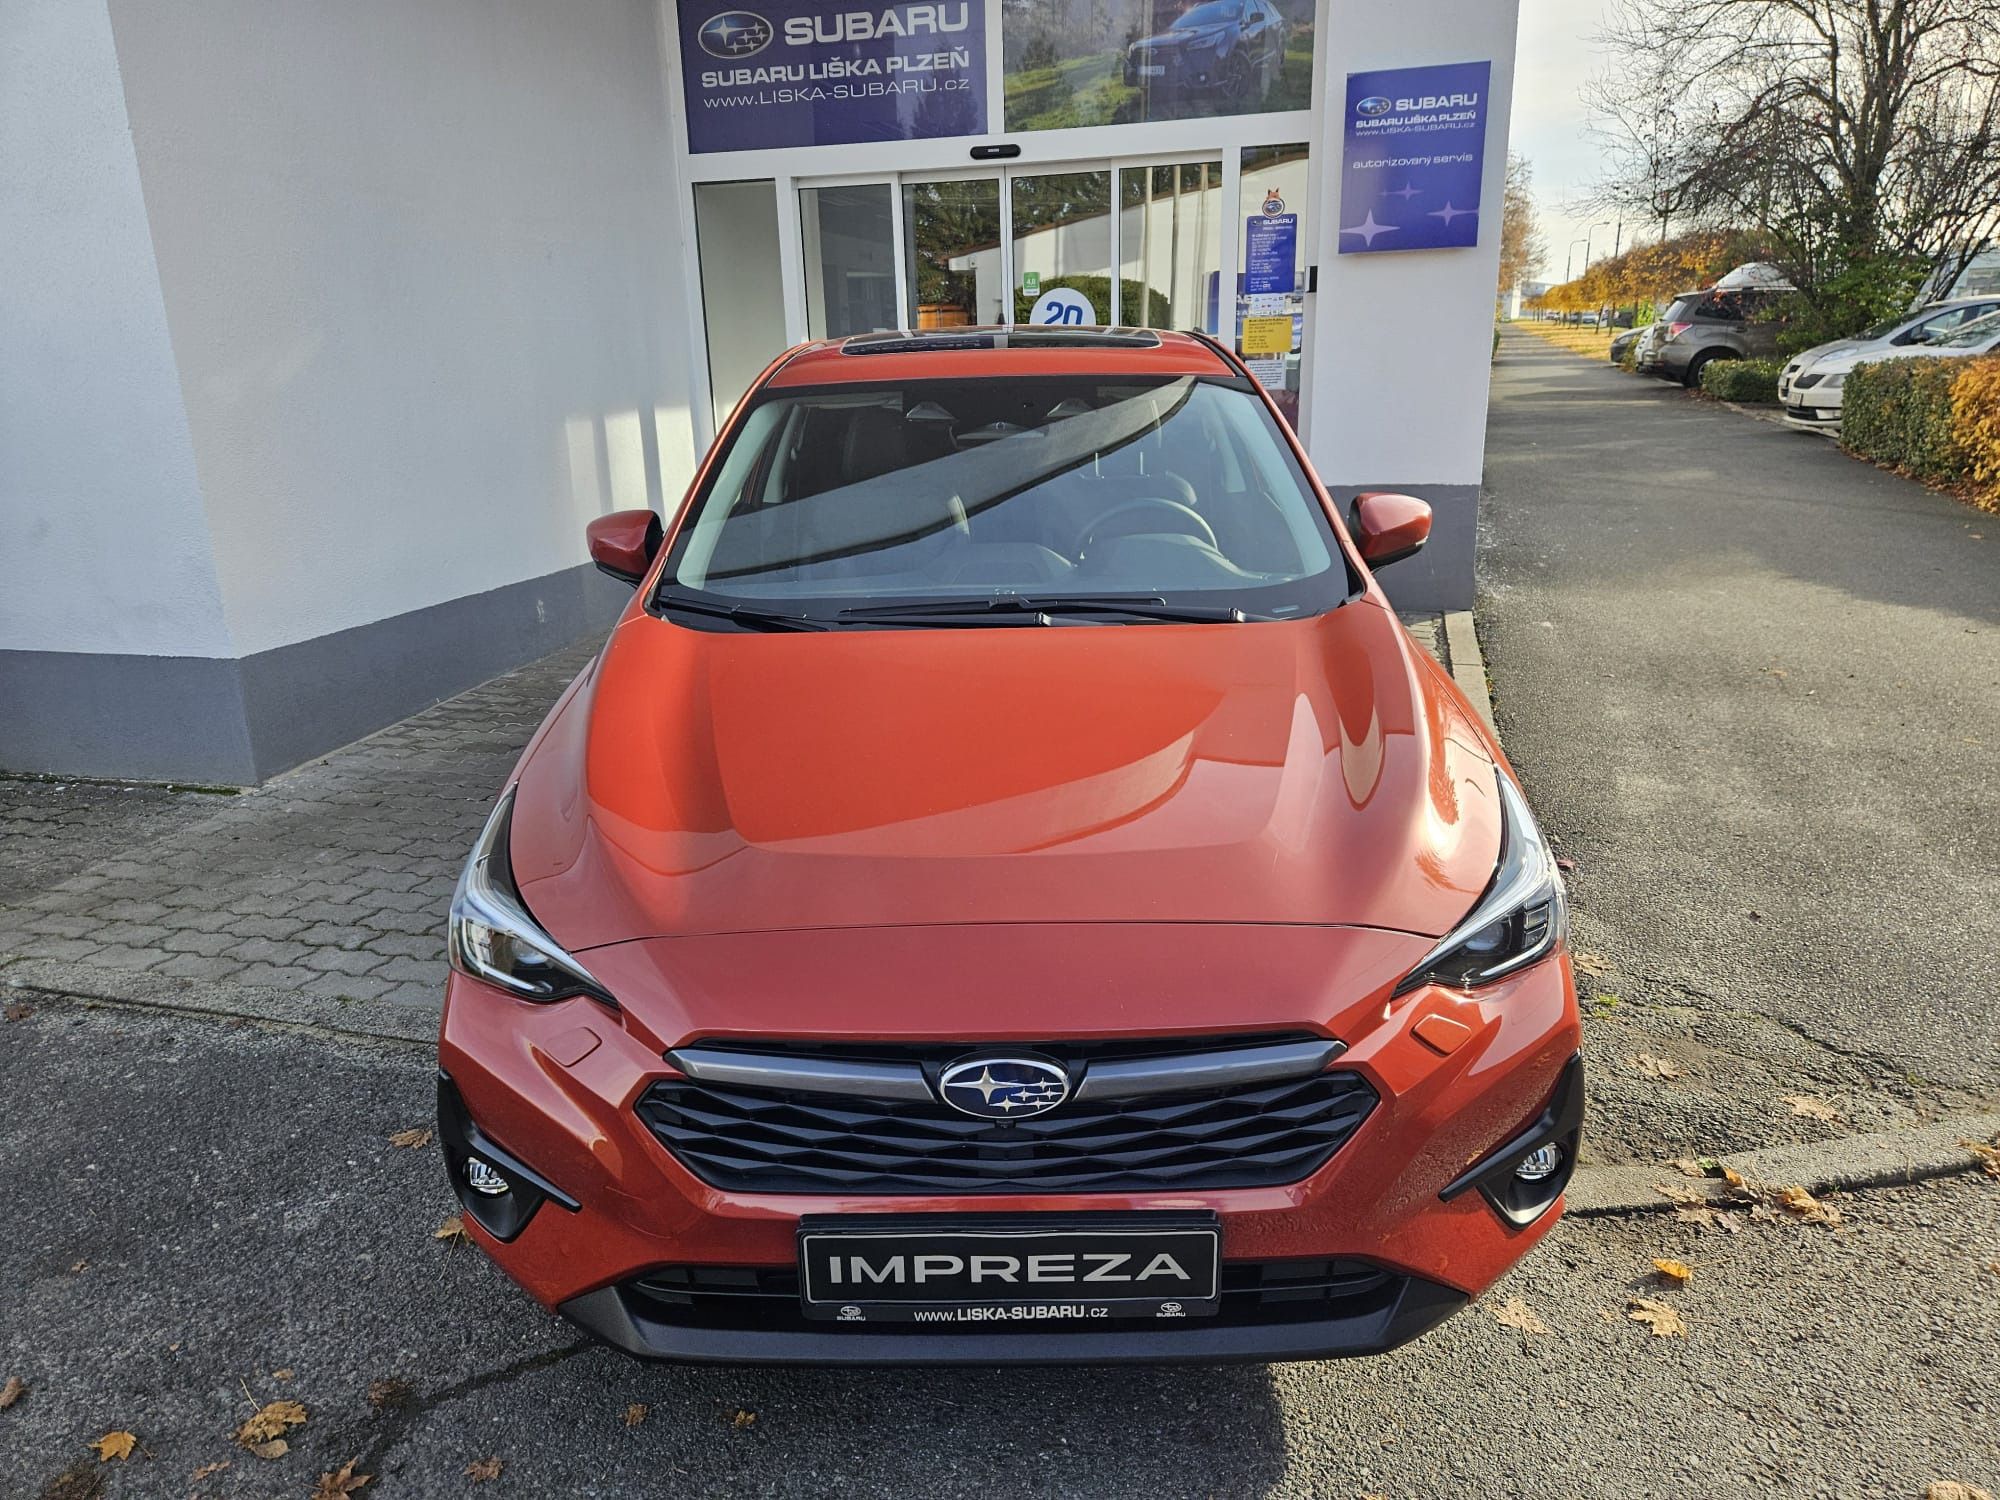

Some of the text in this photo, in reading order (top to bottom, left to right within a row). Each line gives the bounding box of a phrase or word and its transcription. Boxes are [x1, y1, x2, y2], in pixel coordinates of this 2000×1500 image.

[784, 3, 968, 45] SUBARU
[701, 46, 969, 88] SUBARU LIŠKA PLZEŇ
[703, 77, 970, 108] www.LISKA-SUBARU.cz
[1395, 93, 1478, 111] SUBARU
[1355, 110, 1476, 129] SUBARU LIŠKA PLZEŇ
[1352, 152, 1474, 169] autorizovaný servis
[829, 1253, 1191, 1284] IMPREZA
[914, 1305, 1109, 1322] www.LISKA-SUBARU.cz
